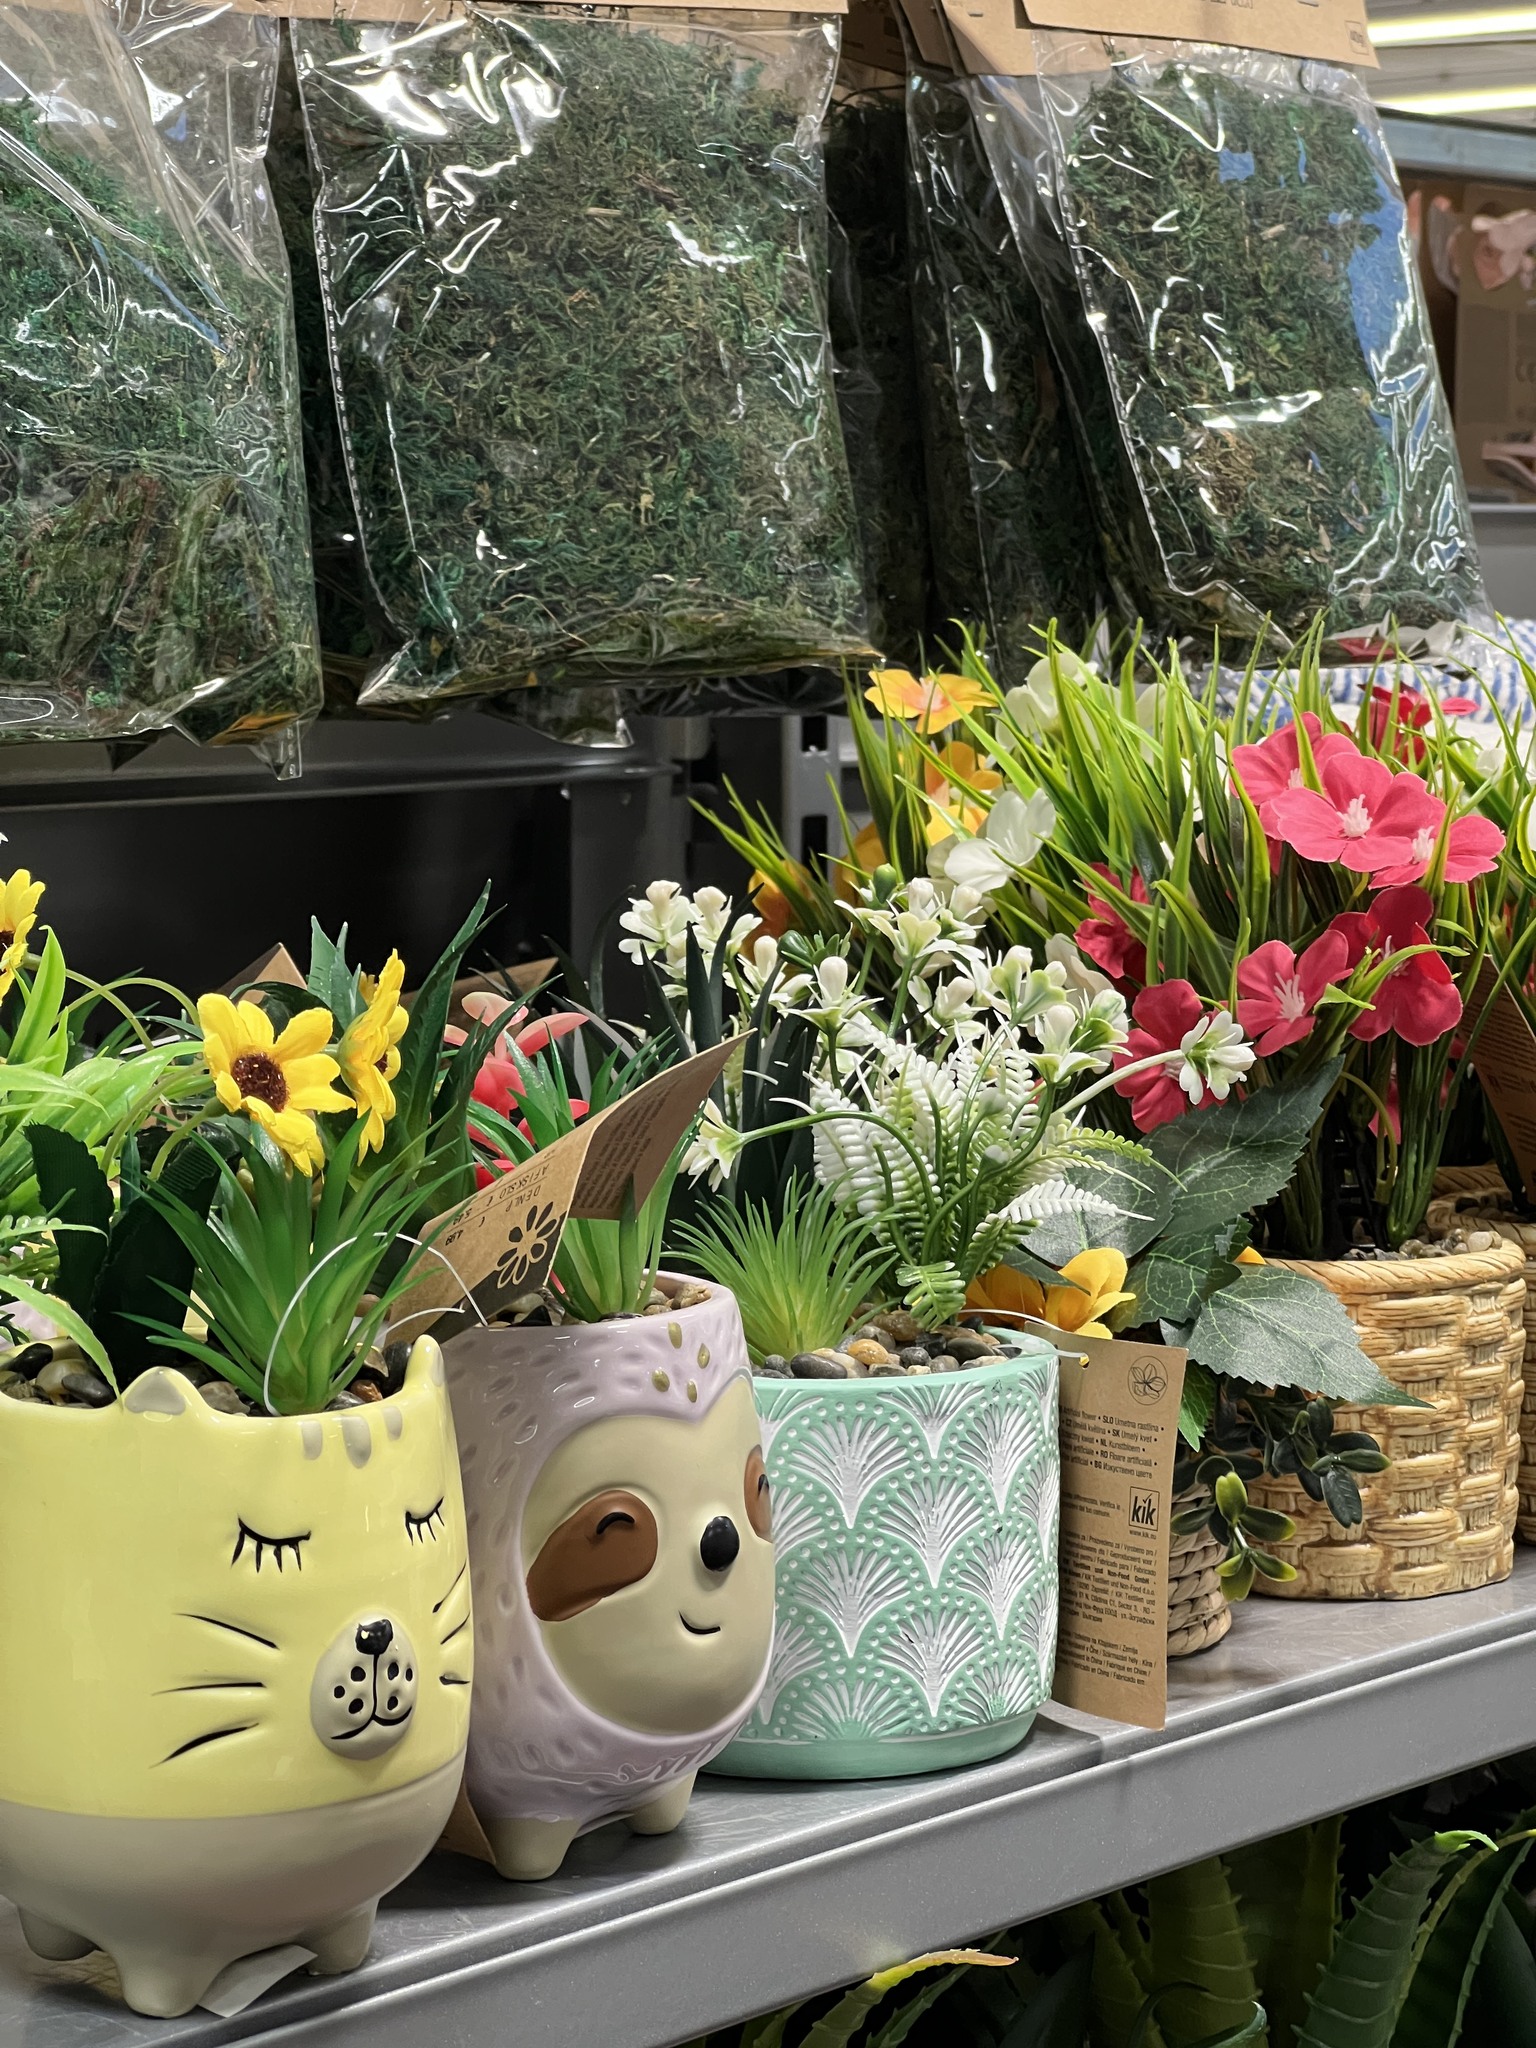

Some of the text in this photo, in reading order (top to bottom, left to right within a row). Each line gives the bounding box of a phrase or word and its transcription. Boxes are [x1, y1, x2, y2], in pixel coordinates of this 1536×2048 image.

[1102, 1415, 1114, 1424] SLO
[1115, 1417, 1136, 1429] Umetna
[1112, 1428, 1120, 1437] SK
[1131, 1493, 1157, 1526] kik
